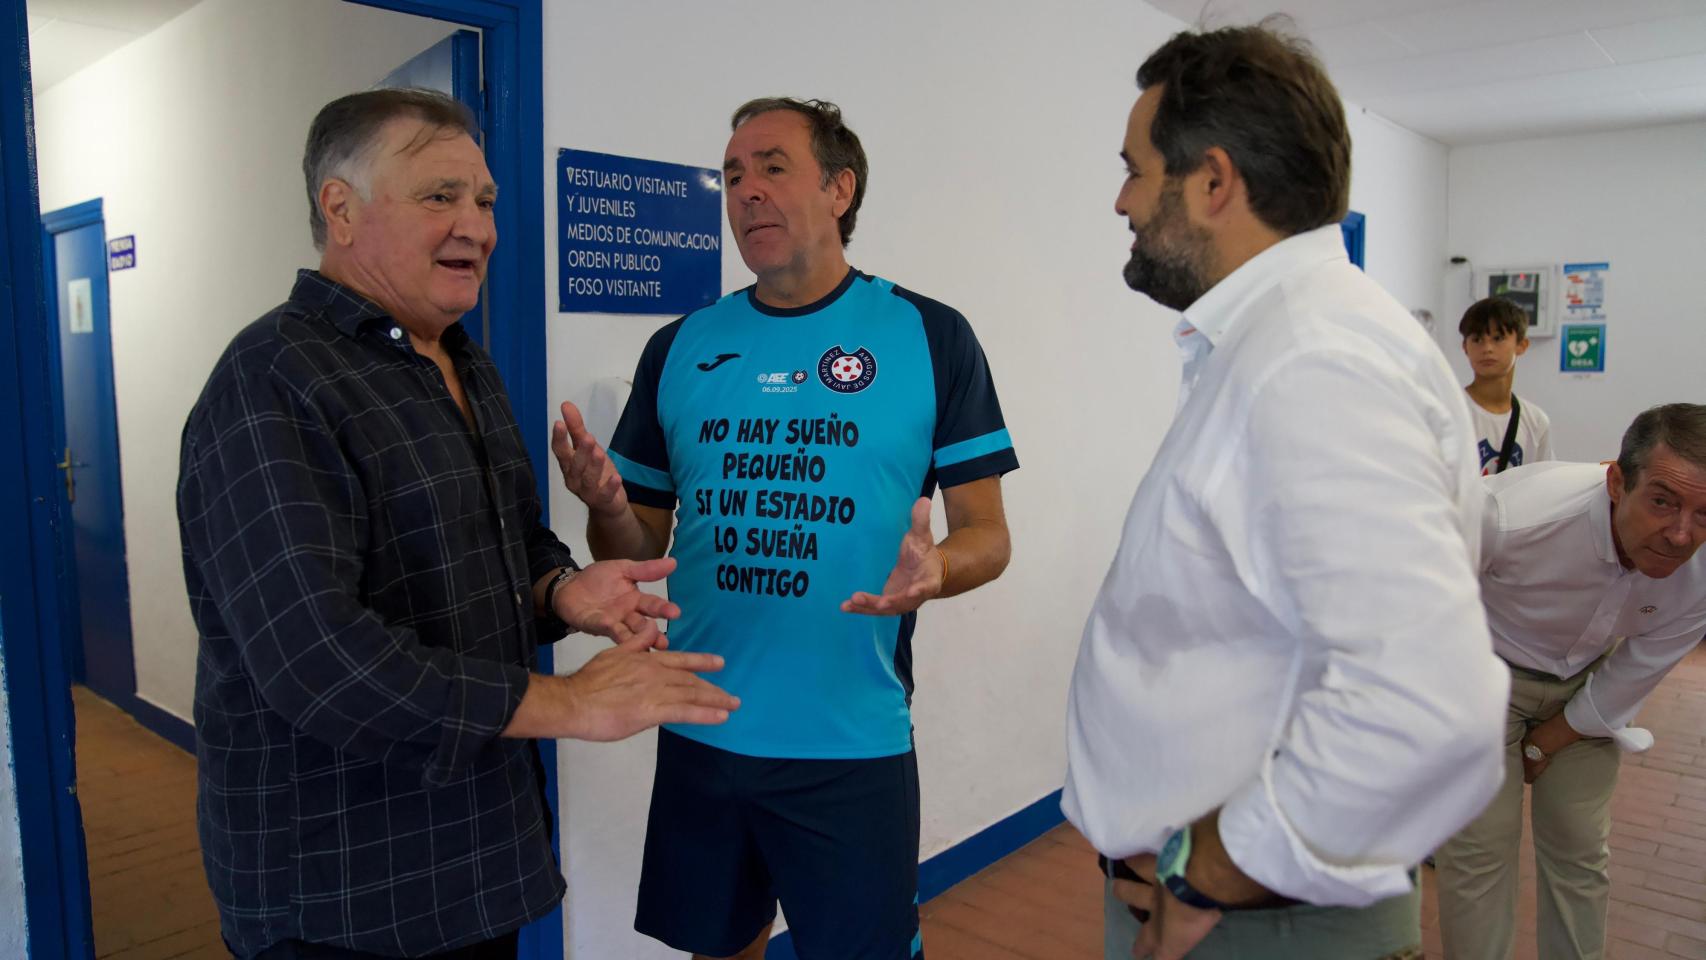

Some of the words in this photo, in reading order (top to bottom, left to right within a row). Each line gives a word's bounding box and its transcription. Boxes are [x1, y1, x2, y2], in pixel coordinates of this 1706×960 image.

[566, 166, 632, 191] VESTUARIO
[634, 175, 688, 198] VISITANTE
[566, 194, 575, 212] Y
[577, 198, 636, 218] JUVENILES
[567, 223, 614, 243] MEDIOS
[616, 226, 631, 244] DE
[634, 228, 719, 251] COMUNICACION
[568, 249, 611, 269] ORDEN
[613, 253, 661, 272] PUBLICO
[568, 277, 603, 296] FOSO
[605, 279, 662, 298] VISITANTE
[821, 349, 841, 384] MARTINEZ
[858, 351, 873, 381] AMIGOS
[832, 382, 851, 390] JAVI
[853, 380, 865, 389] DE
[698, 418, 730, 444] NO
[736, 418, 780, 445] HAY
[785, 412, 859, 448] SUEÑO
[722, 447, 826, 483] PEQUEÑO
[695, 489, 714, 516] SI
[719, 489, 748, 517] UN
[755, 489, 856, 525] ESTADIO
[714, 525, 738, 553] LO
[745, 523, 818, 561] SUEÑA
[716, 564, 809, 598] CONTIGO
